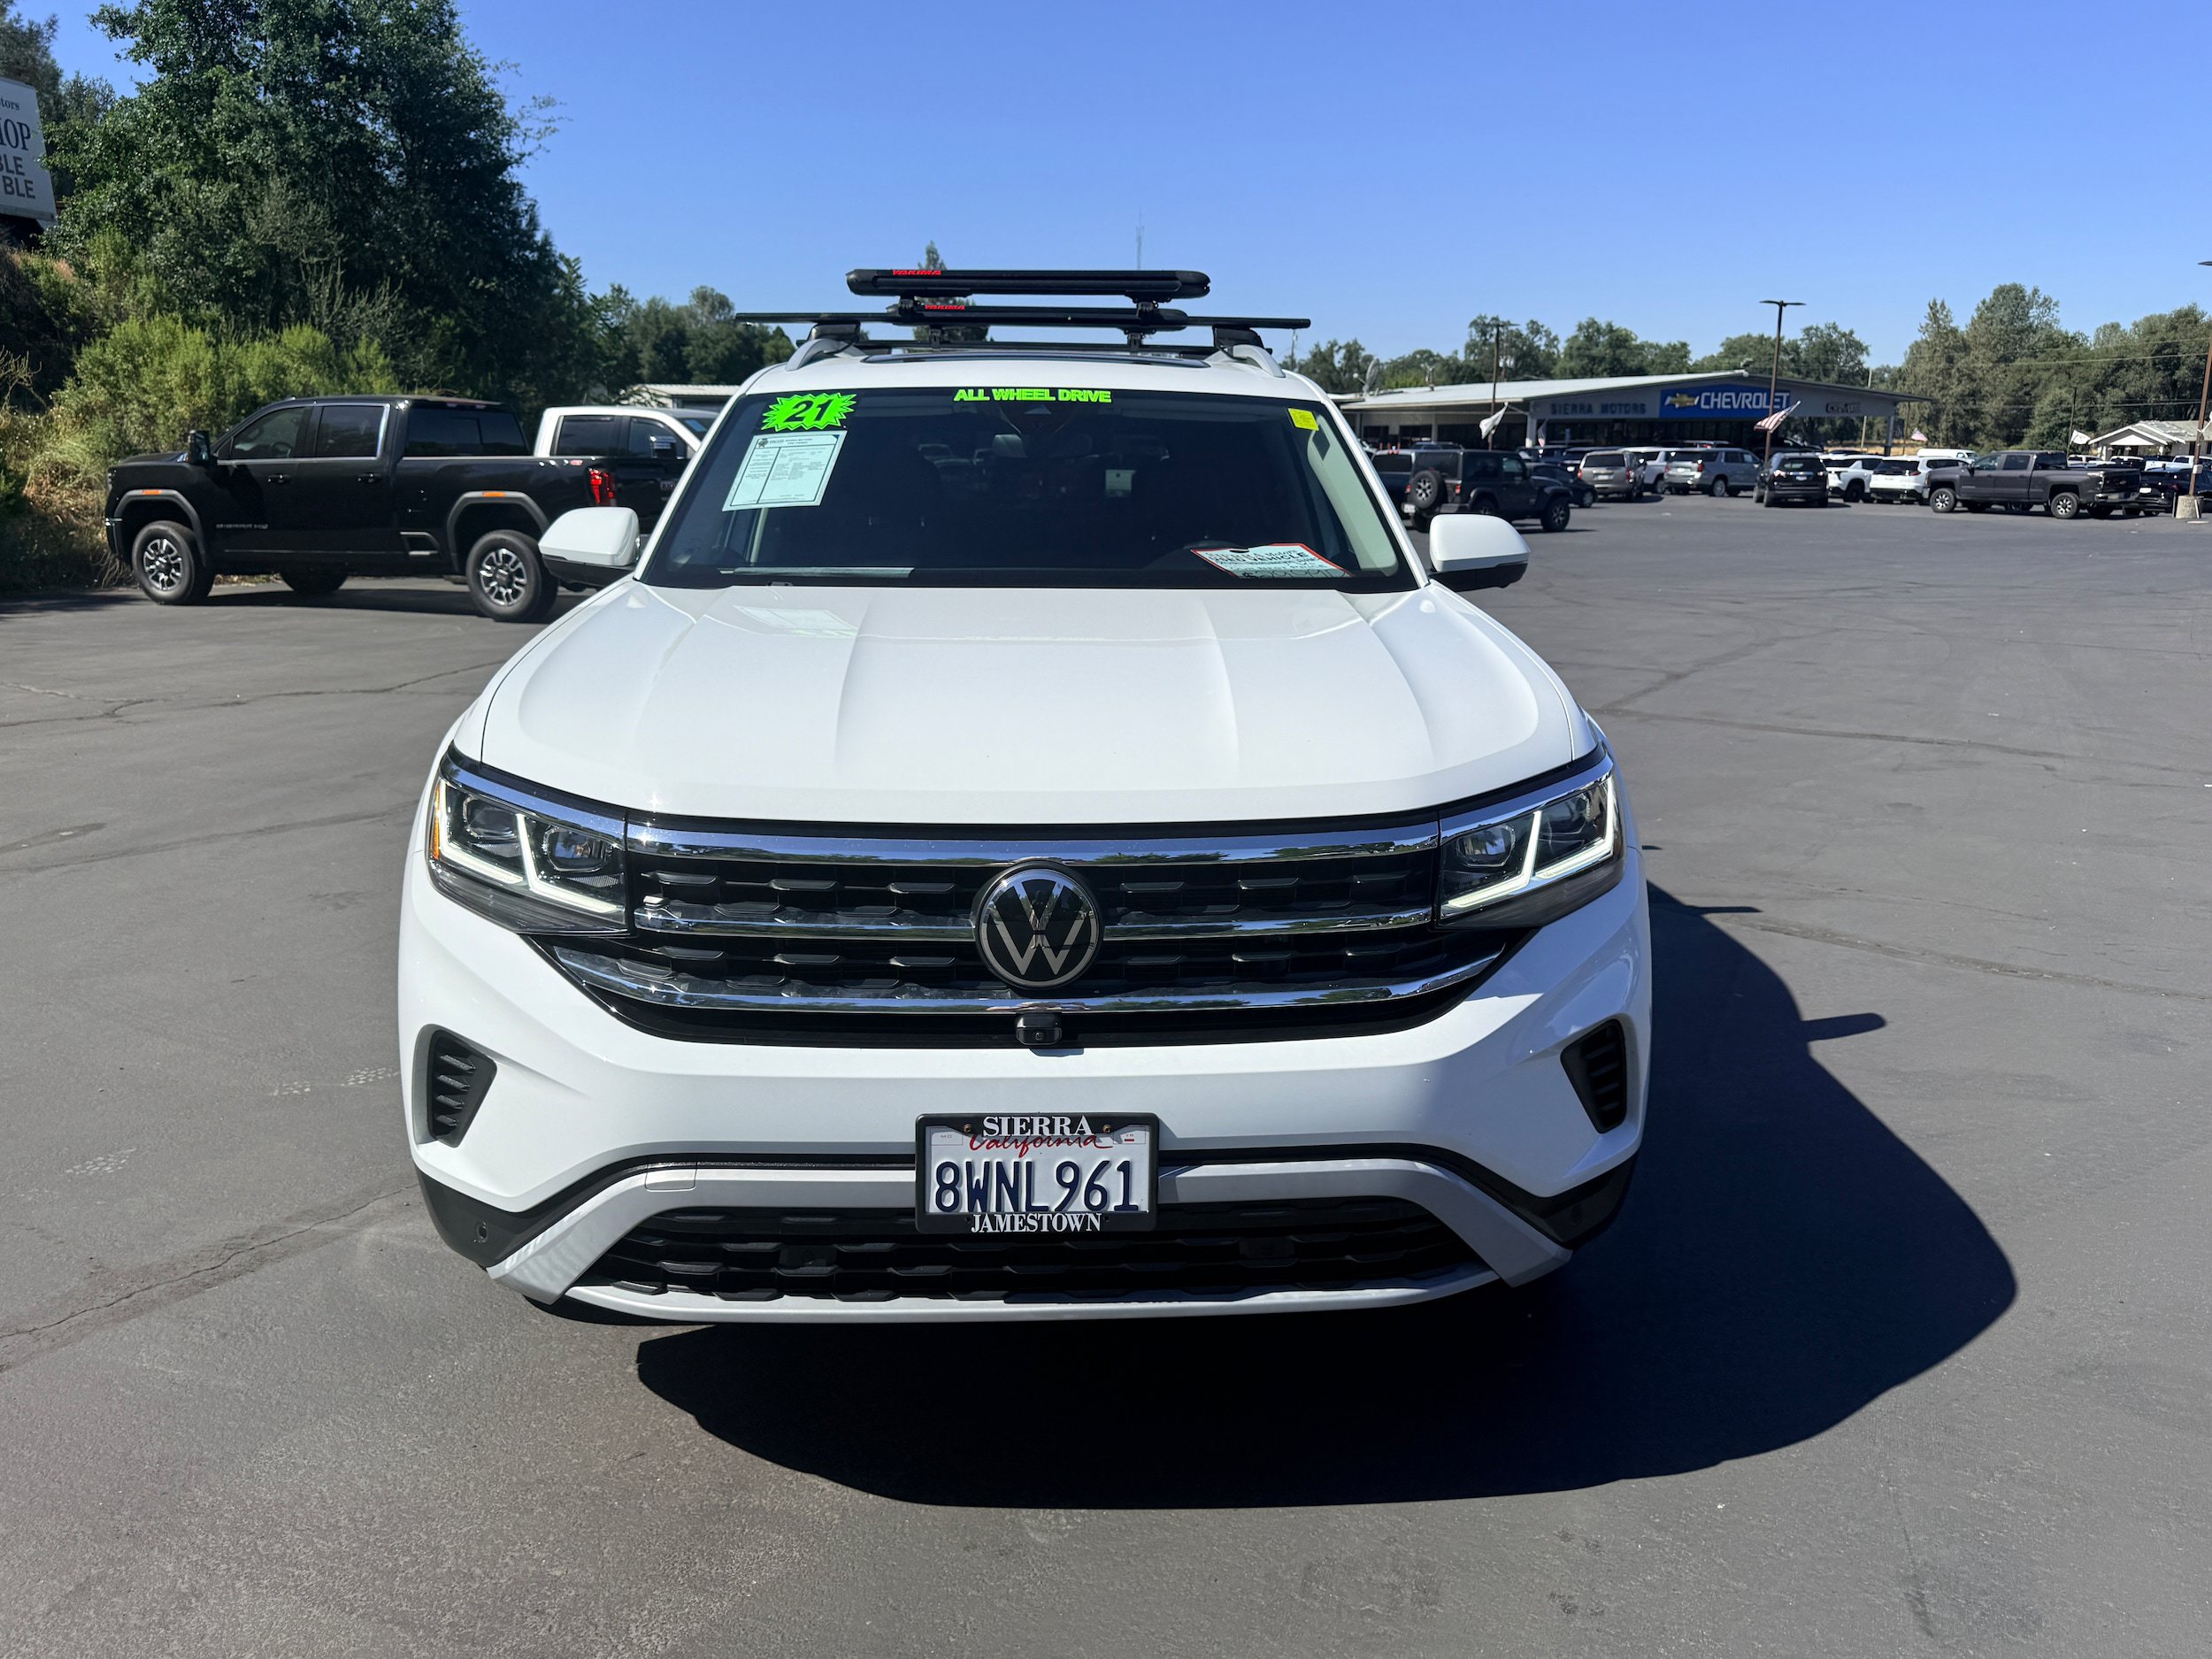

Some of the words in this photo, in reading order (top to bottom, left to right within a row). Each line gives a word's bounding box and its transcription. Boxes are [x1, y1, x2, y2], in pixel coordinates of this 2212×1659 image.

[953, 388, 990, 401] ALL
[992, 388, 1056, 401] WHEEL
[1058, 389, 1112, 403] DRIVE
[1700, 392, 1790, 409] CHEVROLET
[782, 398, 834, 423] 21
[1550, 403, 1593, 415] SIERRA
[1600, 403, 1646, 415] MOTORS
[1249, 551, 1310, 561] VEHICLE
[982, 1115, 1094, 1137] SIERRA
[934, 1160, 1140, 1213] 8WNL961
[971, 1213, 1102, 1233] JAMESTOWN
